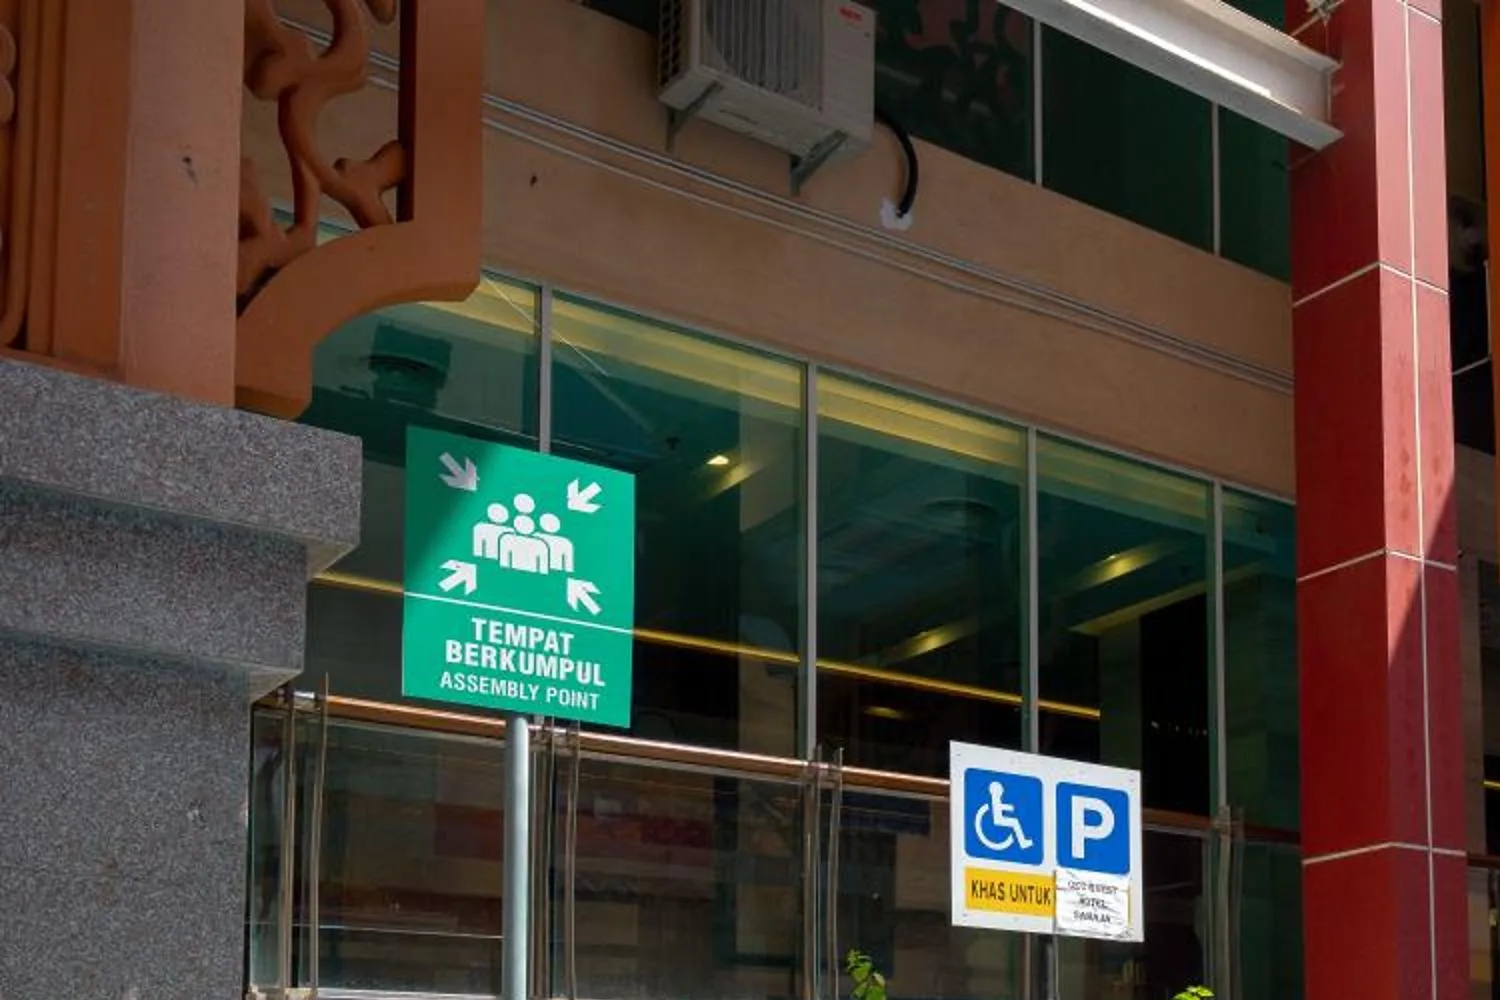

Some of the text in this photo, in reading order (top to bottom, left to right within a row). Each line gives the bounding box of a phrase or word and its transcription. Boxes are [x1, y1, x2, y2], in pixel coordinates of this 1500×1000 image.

[471, 617, 575, 656] TEMPAT
[445, 639, 606, 687] BERKUMPUL
[439, 671, 600, 711] ASSEMBLY POINT
[1071, 795, 1115, 859] P
[971, 879, 1005, 901] KHAS
[1009, 883, 1051, 905] UNTUK
